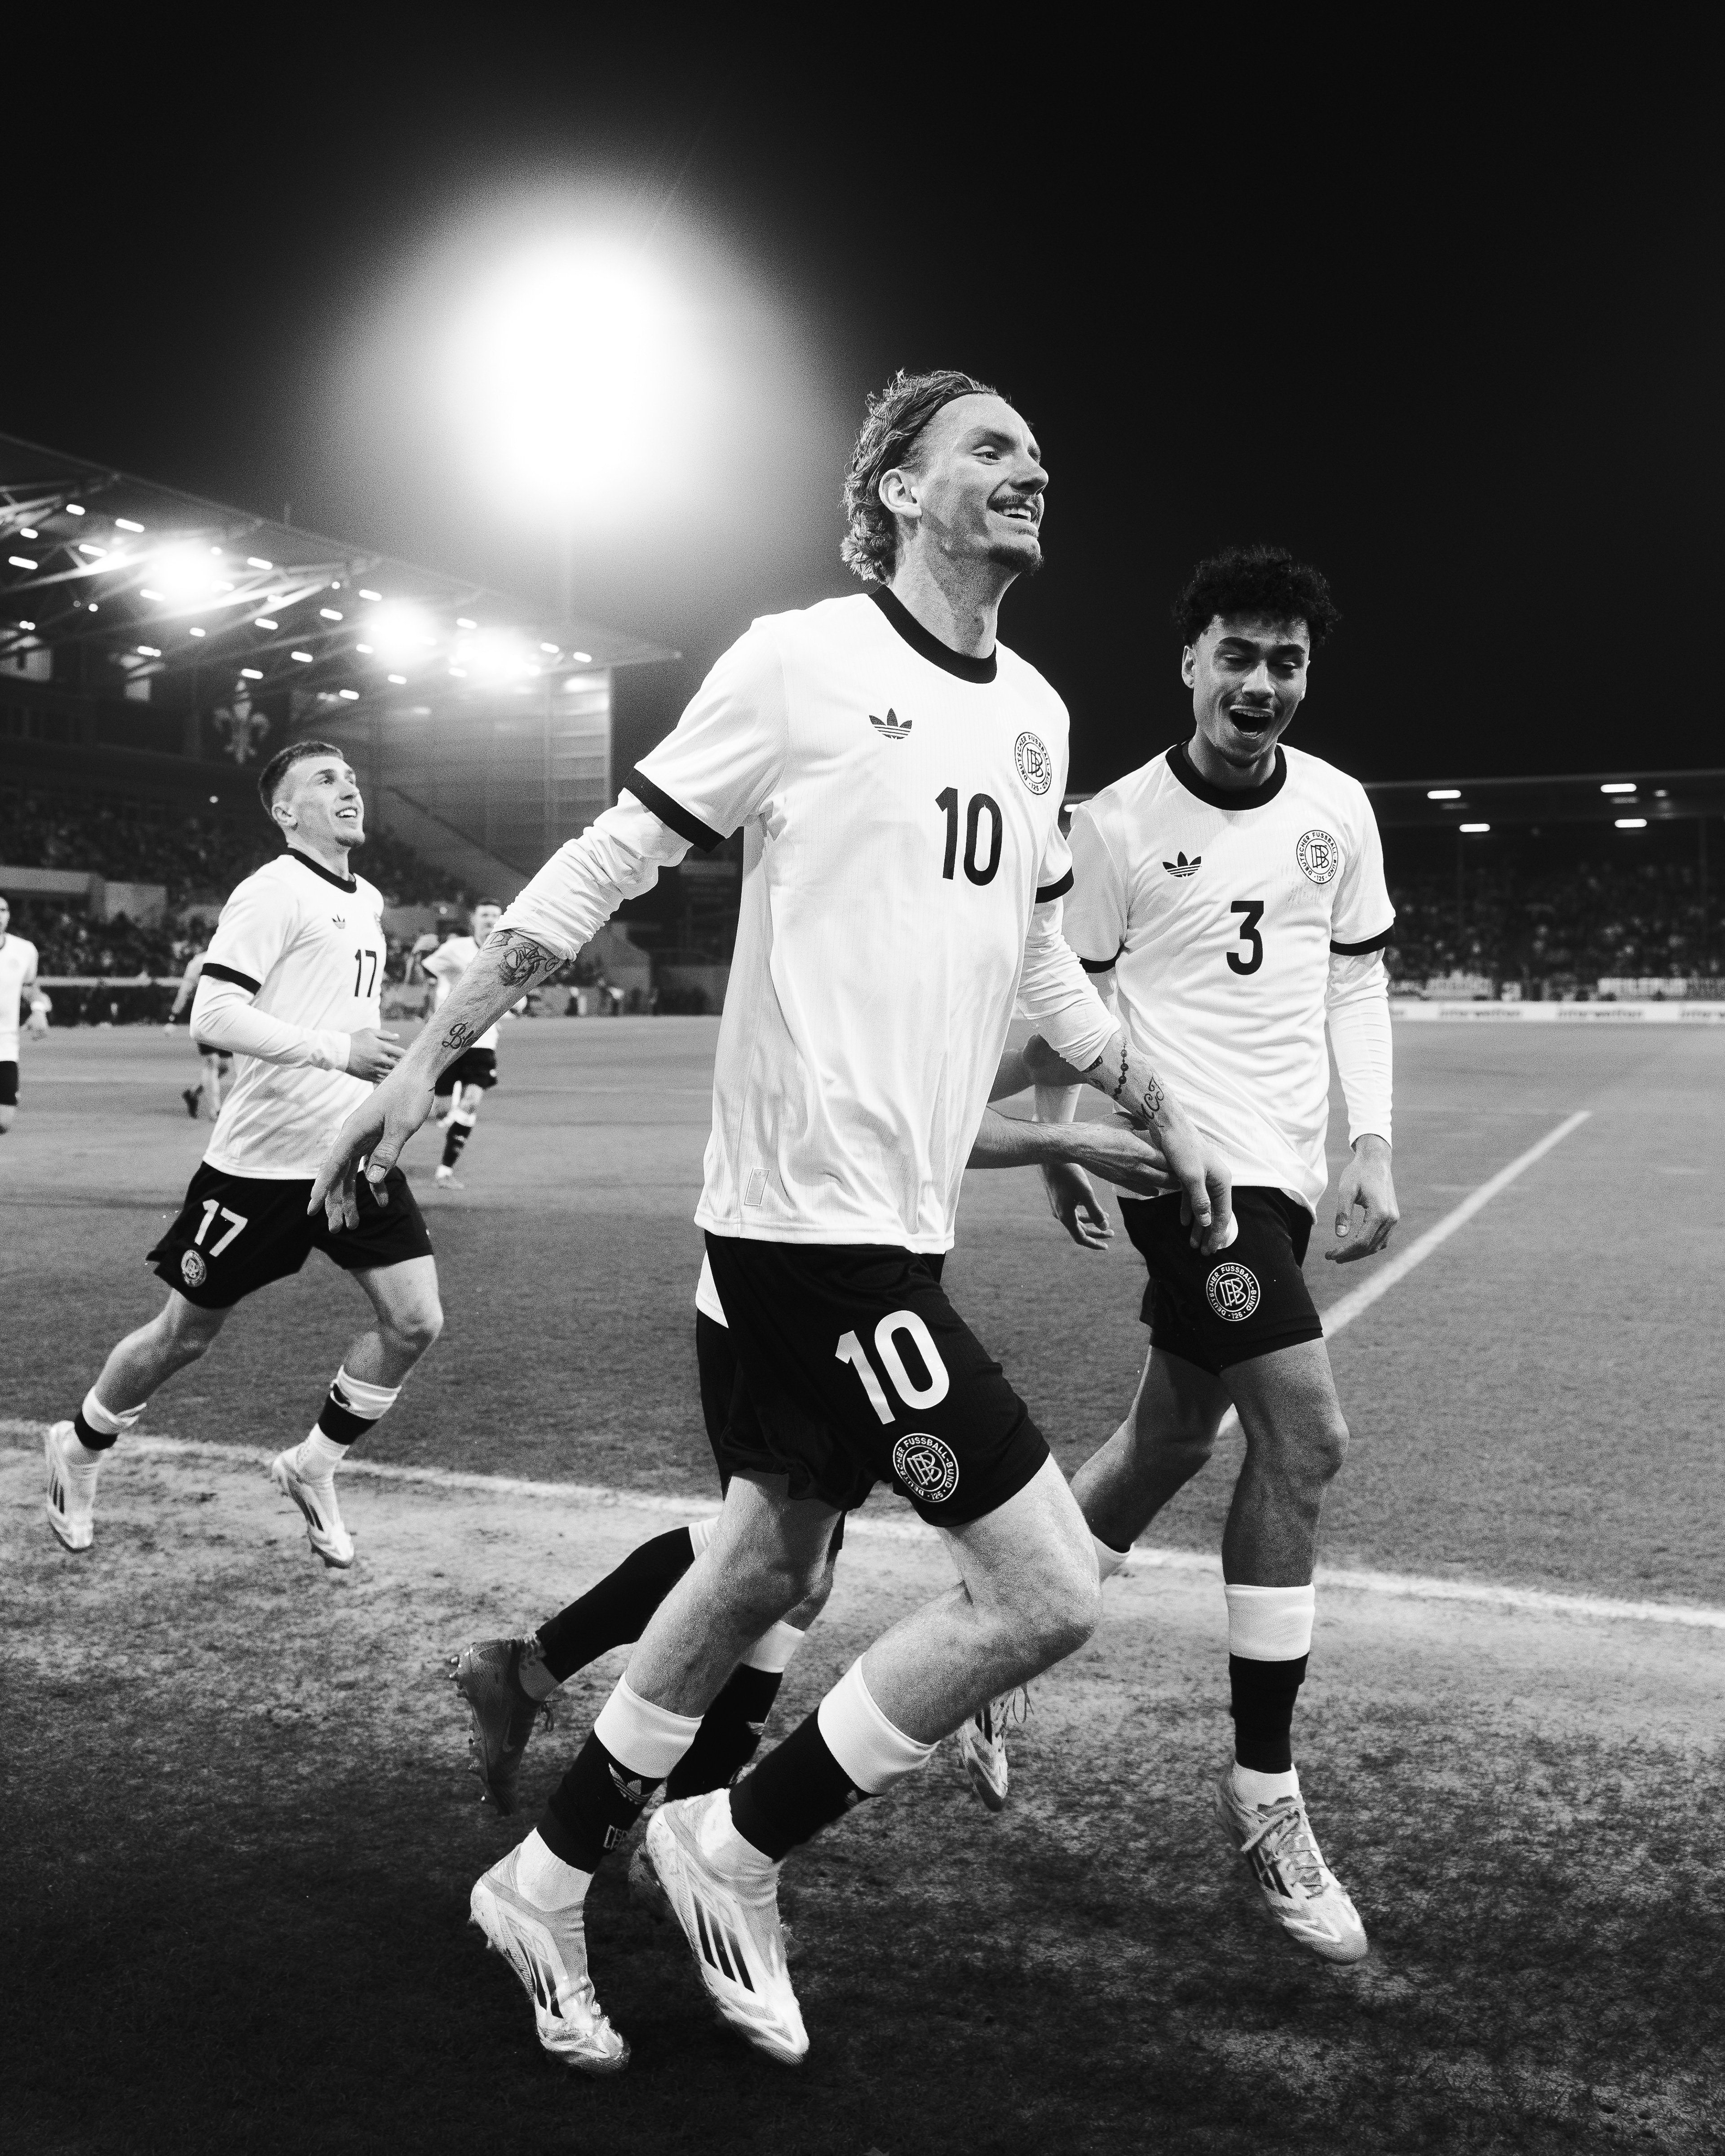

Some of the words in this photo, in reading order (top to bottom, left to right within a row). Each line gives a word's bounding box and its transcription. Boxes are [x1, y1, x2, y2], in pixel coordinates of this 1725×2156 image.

[1031, 783, 1039, 791] 125
[935, 786, 1003, 886] 10
[1299, 835, 1313, 875] DEUTSCHER
[1226, 900, 1264, 976] 3
[354, 949, 377, 998] 17
[194, 1199, 248, 1257] 17
[1209, 1272, 1226, 1316] DEUTSCHER
[835, 1310, 950, 1425] 10
[931, 1490, 943, 1500] 125
